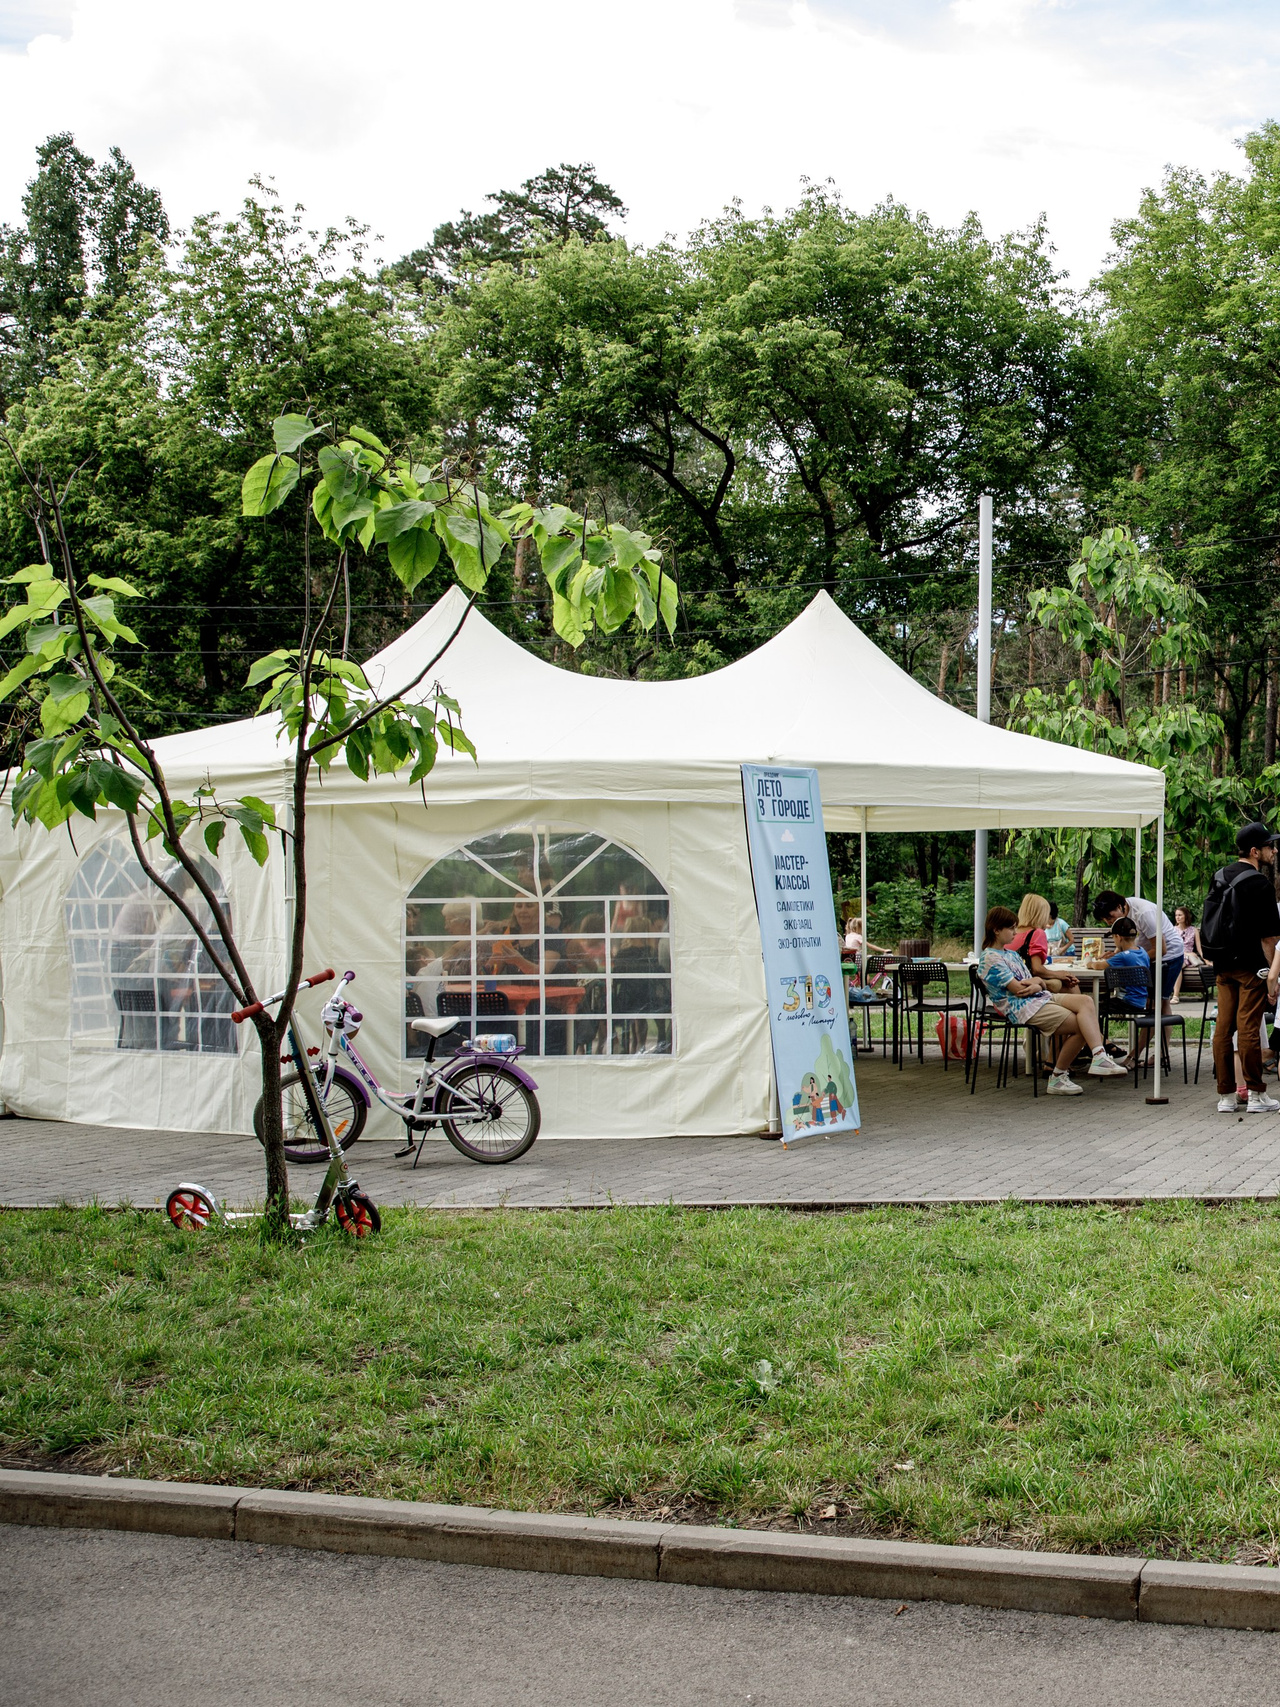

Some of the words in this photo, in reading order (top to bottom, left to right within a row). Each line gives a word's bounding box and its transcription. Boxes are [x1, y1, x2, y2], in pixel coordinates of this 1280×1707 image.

[757, 779, 783, 797] ЛЕТО
[758, 799, 766, 816] В
[772, 799, 811, 820] ГОРОДЕ
[775, 874, 810, 890] КЛАССЫ
[780, 974, 831, 1011] 319
